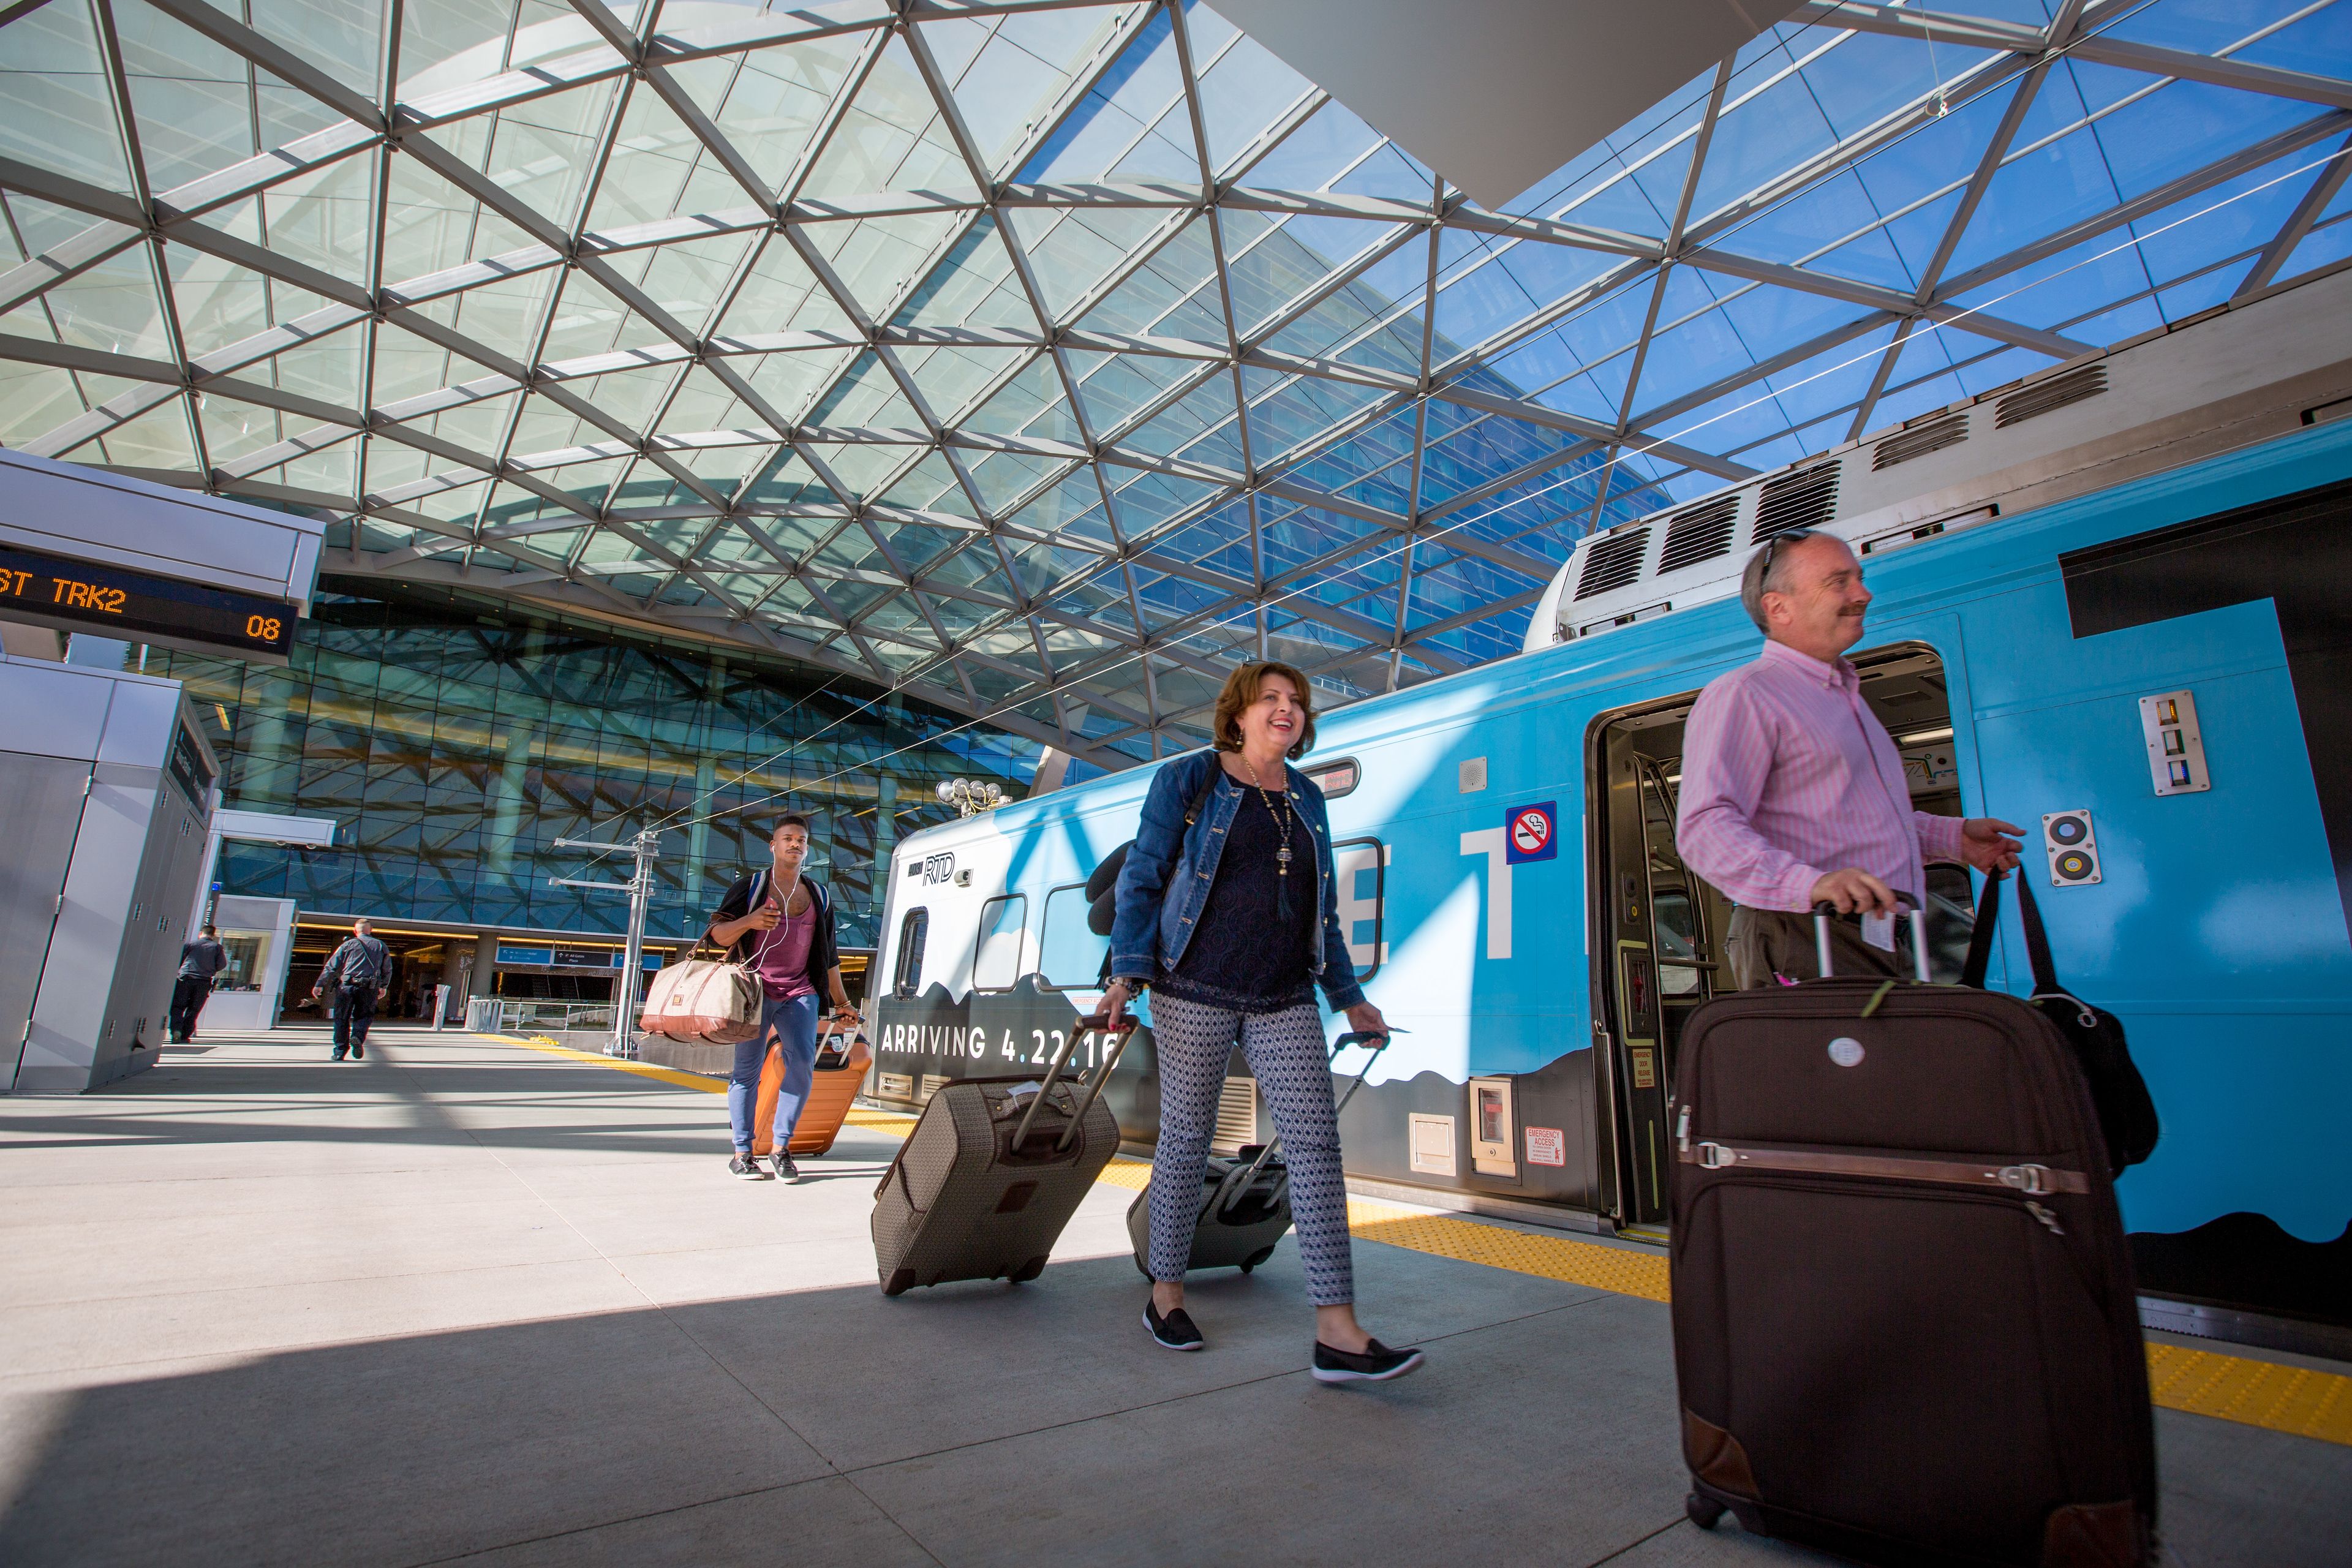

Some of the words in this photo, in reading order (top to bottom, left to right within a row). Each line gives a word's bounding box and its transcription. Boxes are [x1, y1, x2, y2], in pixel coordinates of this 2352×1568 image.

[53, 578, 126, 613] TRK2
[246, 615, 281, 640] 08
[922, 851, 955, 886] RTD
[881, 1024, 986, 1059] ARRIVING
[1001, 1028, 1120, 1070] 4.22.16
[1529, 1129, 1559, 1139] EMERGENCY
